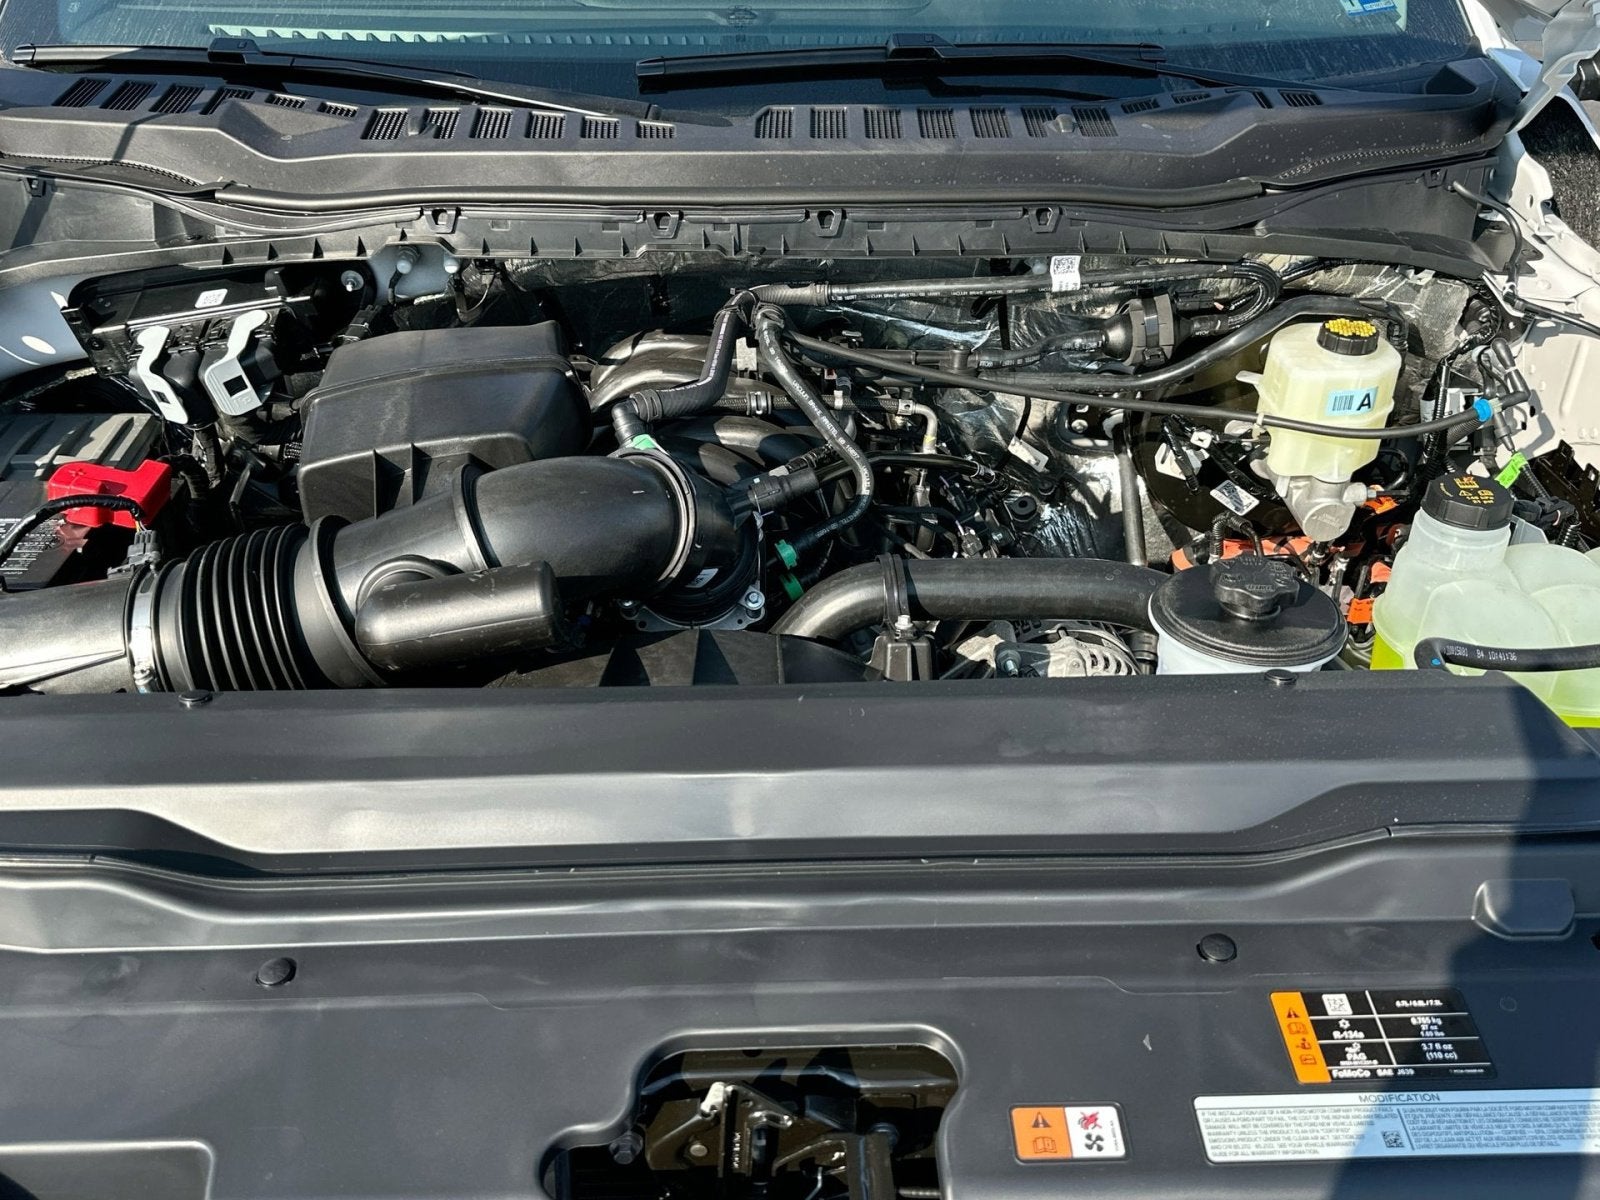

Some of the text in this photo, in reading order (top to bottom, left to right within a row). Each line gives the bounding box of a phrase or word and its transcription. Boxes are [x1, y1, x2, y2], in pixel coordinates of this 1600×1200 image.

[1356, 392, 1372, 411] A
[1431, 1016, 1442, 1026] kg
[1332, 1030, 1365, 1040] R-134a
[1346, 1052, 1367, 1060] PAG
[1426, 1051, 1458, 1061] (110 cc)
[1332, 1069, 1371, 1078] FoMoCo
[1376, 1068, 1394, 1077] SAE
[1358, 1093, 1440, 1103] MODIFICATION
